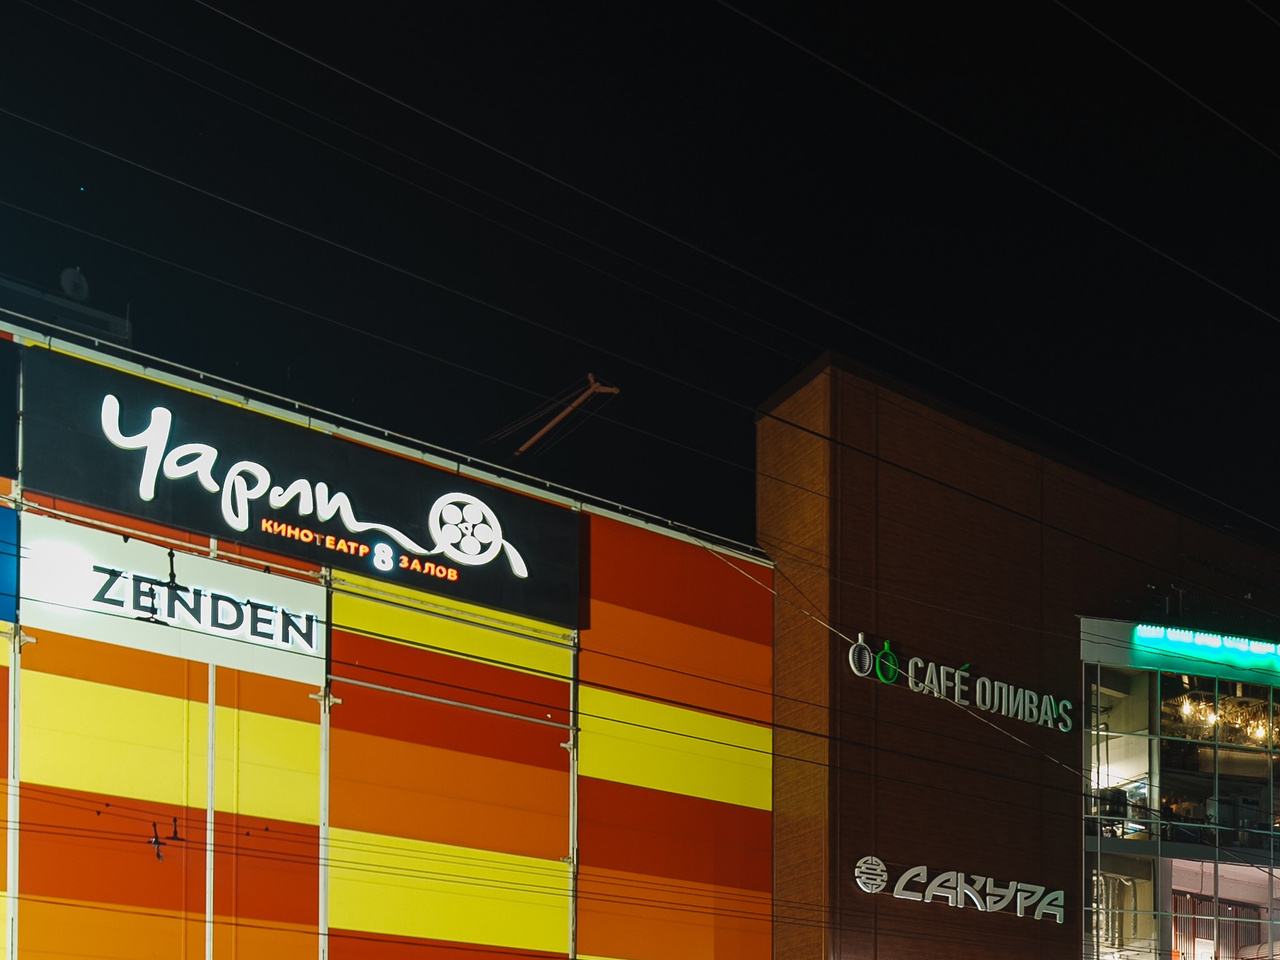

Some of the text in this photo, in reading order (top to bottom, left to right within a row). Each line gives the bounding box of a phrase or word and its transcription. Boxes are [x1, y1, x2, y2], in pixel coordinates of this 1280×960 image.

[101, 394, 388, 533] Чарли
[261, 518, 459, 581] КИНОТЕАТР 8 ЗАЛОВ
[92, 565, 318, 649] ZENDEN
[908, 656, 970, 706] CAFÉ
